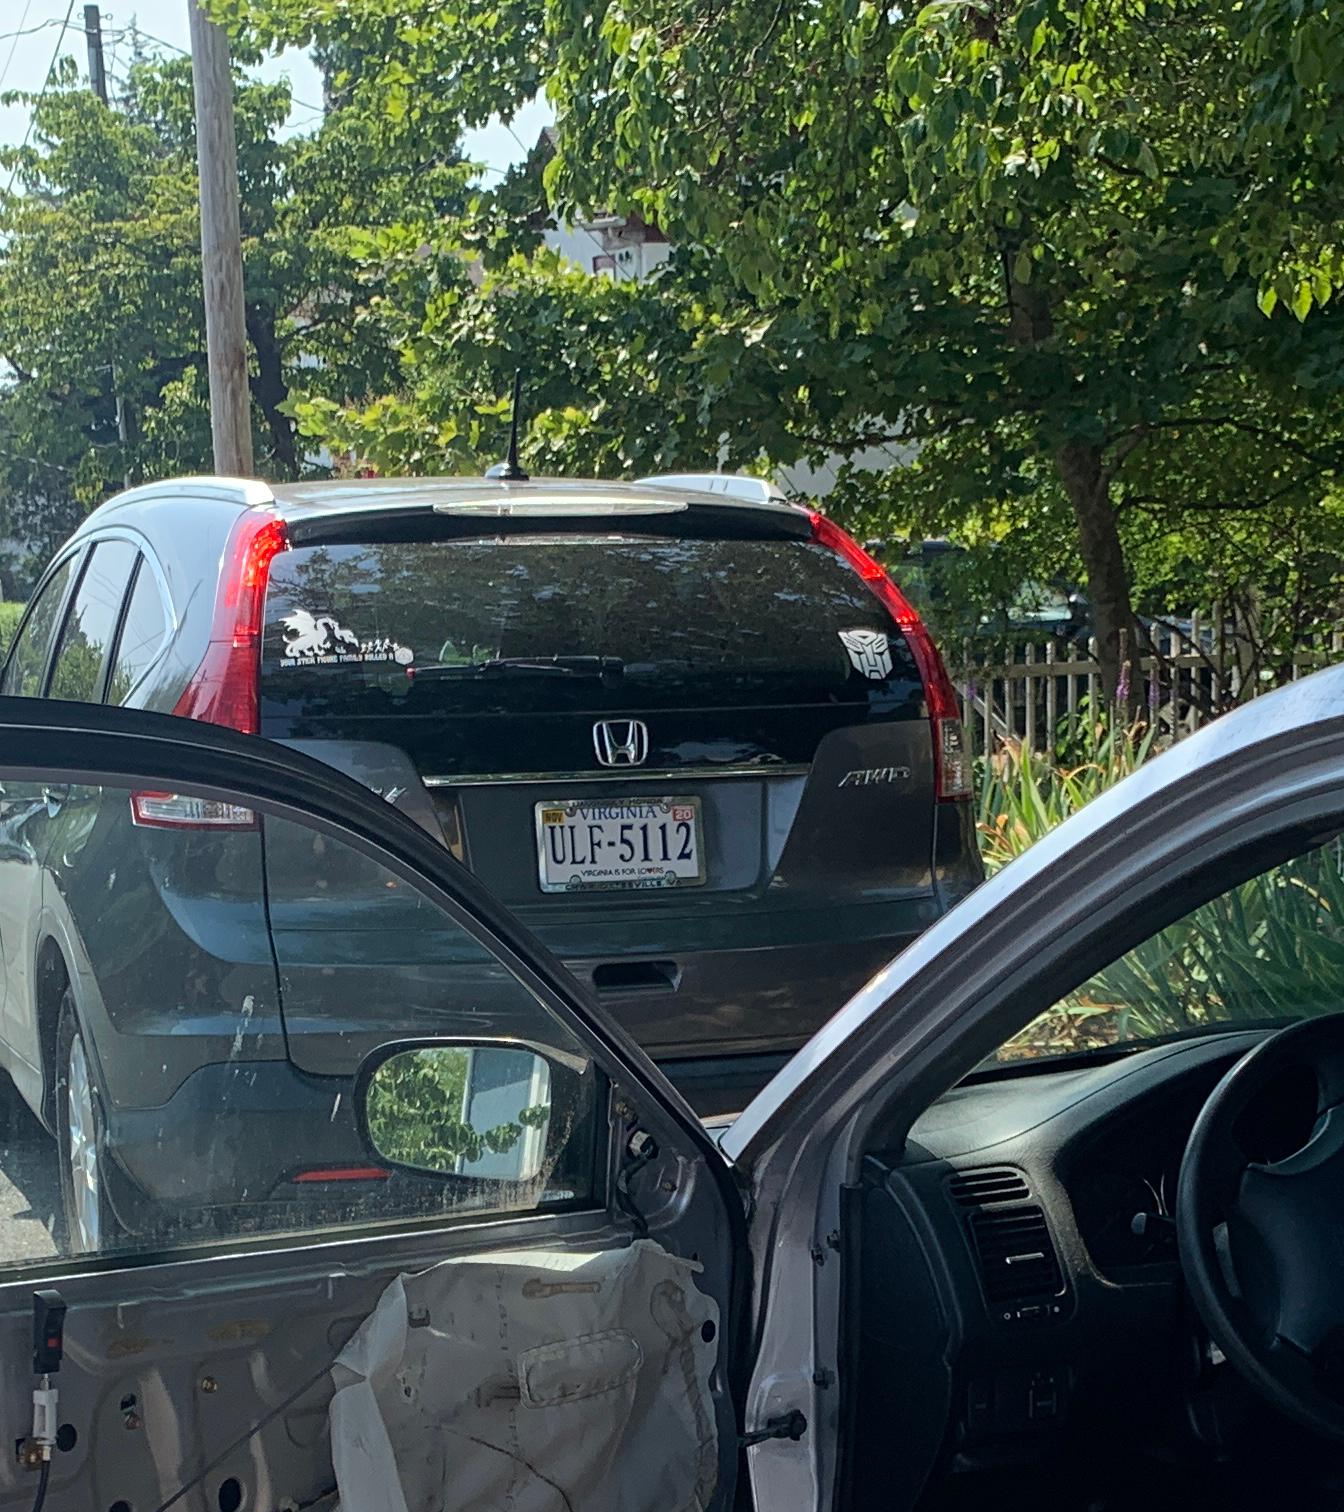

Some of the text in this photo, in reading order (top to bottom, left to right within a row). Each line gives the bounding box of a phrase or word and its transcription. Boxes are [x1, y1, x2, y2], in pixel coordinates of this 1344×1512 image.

[837, 766, 911, 787] AWD
[545, 812, 563, 822] NOV
[580, 806, 657, 820] VIRGINIA
[674, 809, 691, 819] 20
[548, 822, 693, 865] ULF-5112
[580, 868, 614, 876] VIRGINIA
[621, 868, 635, 876] FOR
